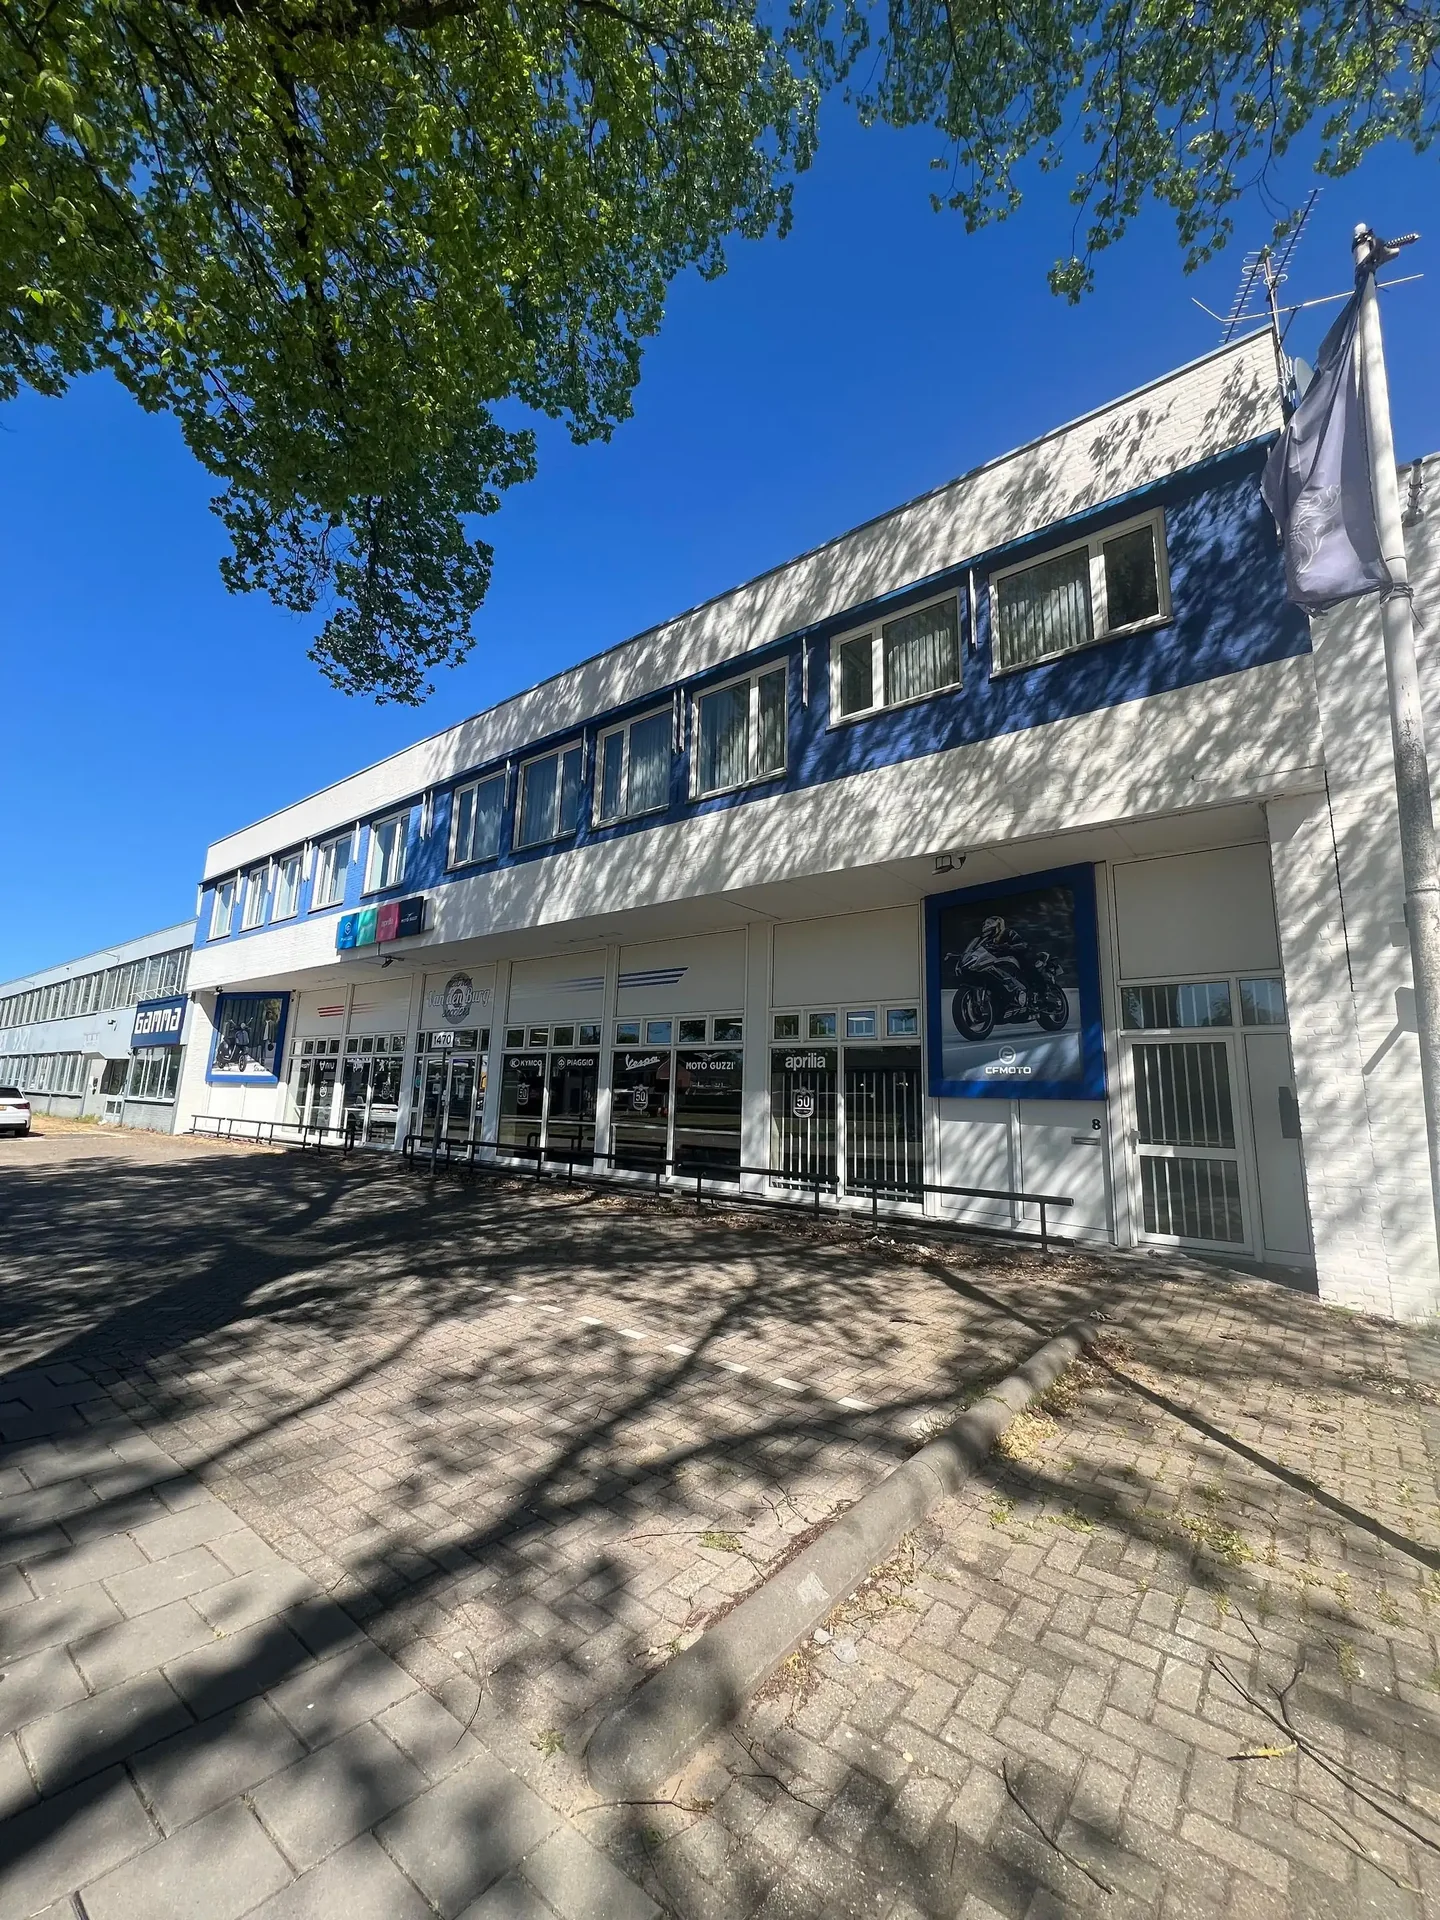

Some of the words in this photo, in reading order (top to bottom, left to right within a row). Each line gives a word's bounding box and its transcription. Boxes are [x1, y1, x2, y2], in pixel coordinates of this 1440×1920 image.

[446, 988, 463, 1005] den
[465, 986, 491, 1007] Burg
[433, 1034, 452, 1045] 1470
[626, 1054, 660, 1071] Vespa
[686, 1062, 707, 1070] MOTO
[710, 1062, 734, 1070] GUZZI
[785, 1052, 826, 1071] aprilia
[985, 1066, 1032, 1074] CFMOTO
[635, 1091, 646, 1102] 50
[796, 1095, 810, 1108] 50
[1091, 1118, 1102, 1130] 8
